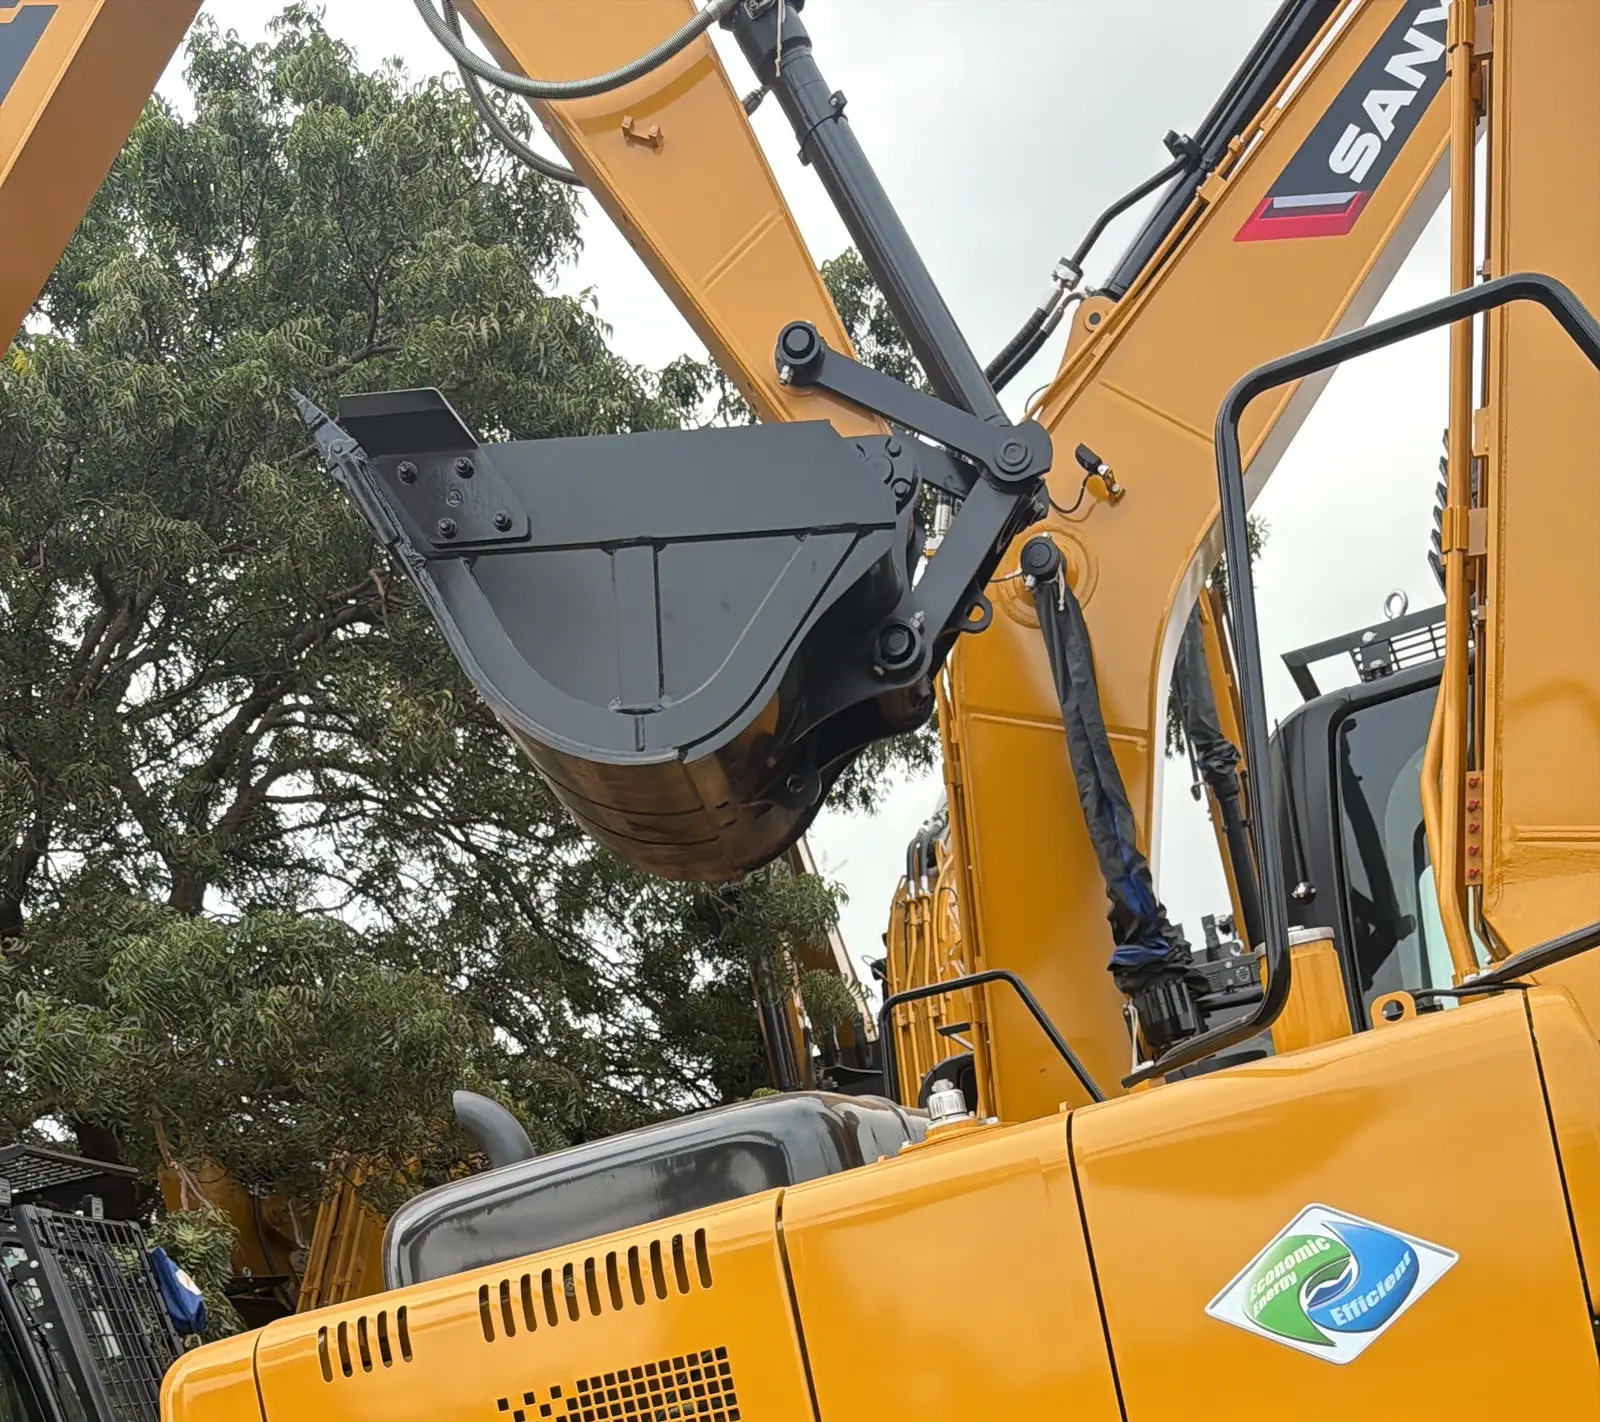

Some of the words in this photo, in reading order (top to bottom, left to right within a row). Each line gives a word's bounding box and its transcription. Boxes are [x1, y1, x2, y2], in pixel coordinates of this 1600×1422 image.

[1249, 1236, 1331, 1300] Economic
[1252, 1271, 1298, 1318] Energy
[1329, 1250, 1412, 1326] Efficient
